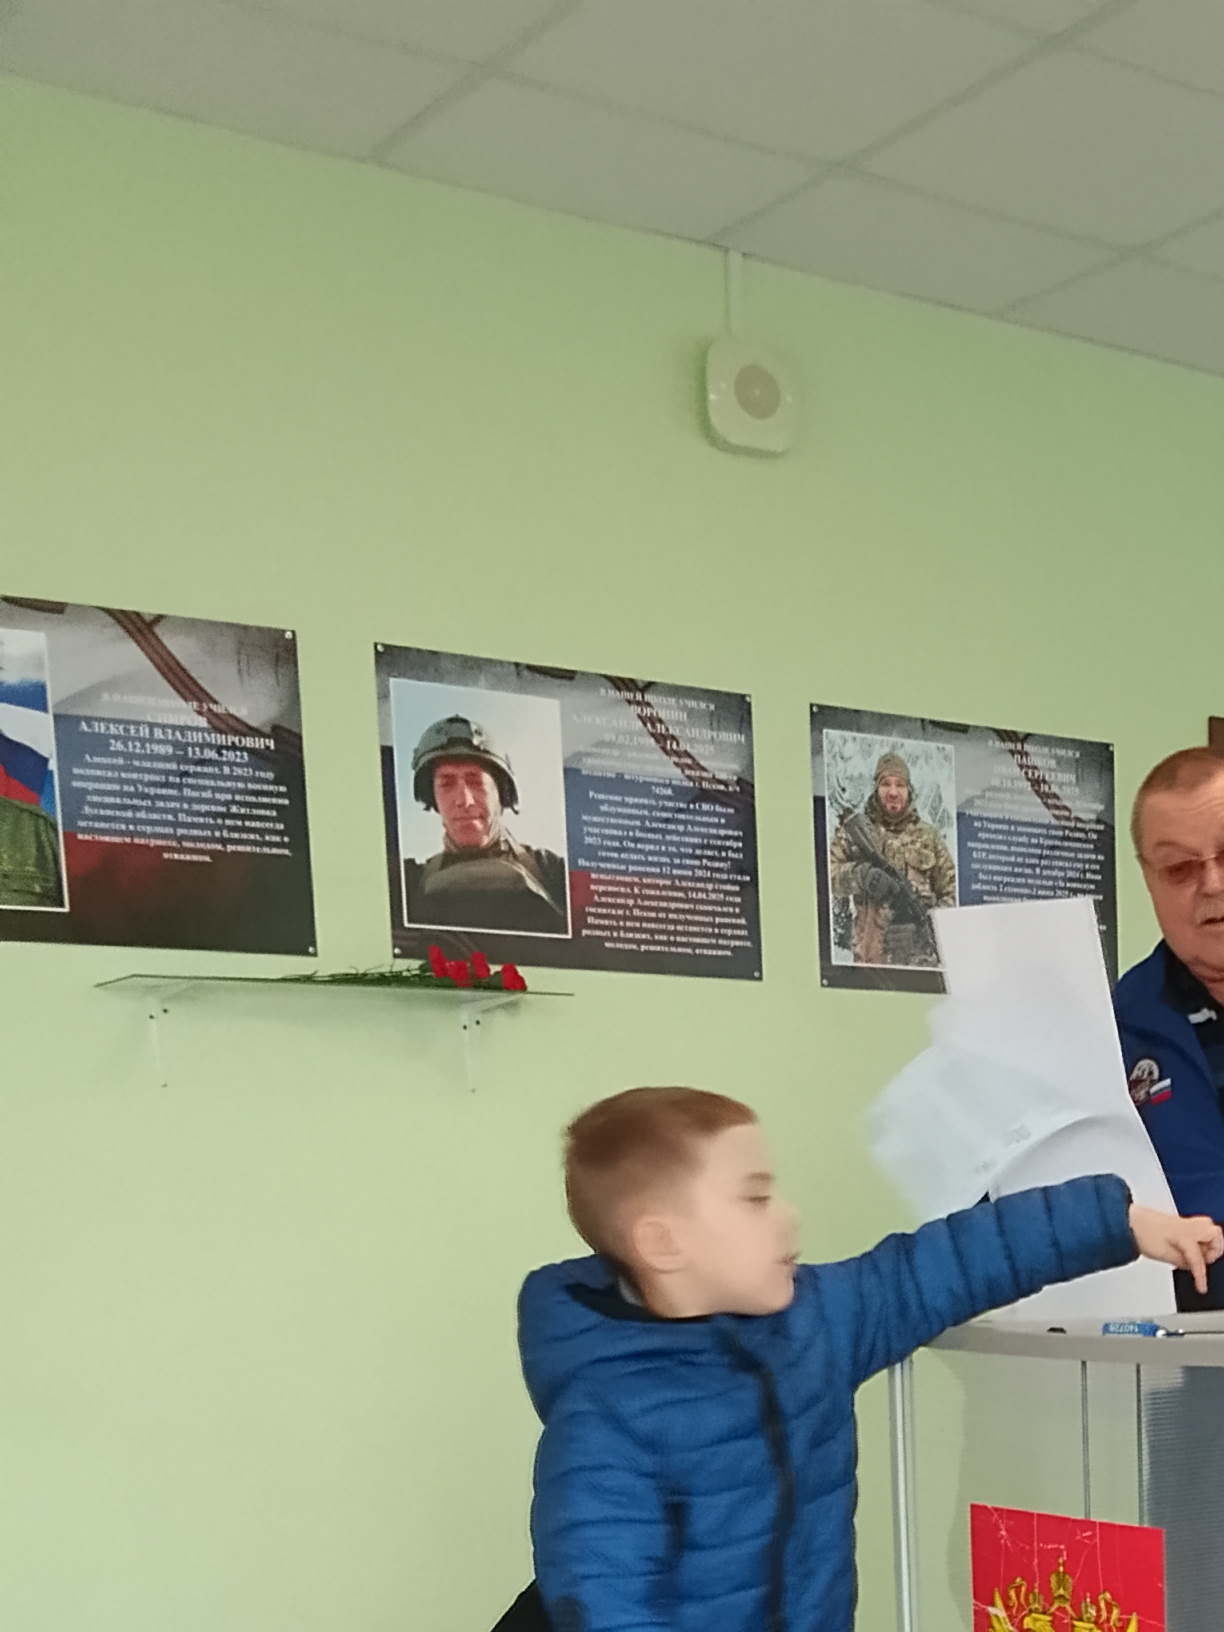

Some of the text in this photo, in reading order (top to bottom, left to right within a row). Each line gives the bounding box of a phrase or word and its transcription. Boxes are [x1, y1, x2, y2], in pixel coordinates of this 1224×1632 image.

[78, 717, 275, 751] АЛЕКСЕЙ ВЛАДИМИРОВИЧ
[647, 722, 744, 744] АЛЕКСАНДРОВИЧ
[108, 739, 173, 756] 26.12.1989
[186, 746, 248, 763] 13.06.2023
